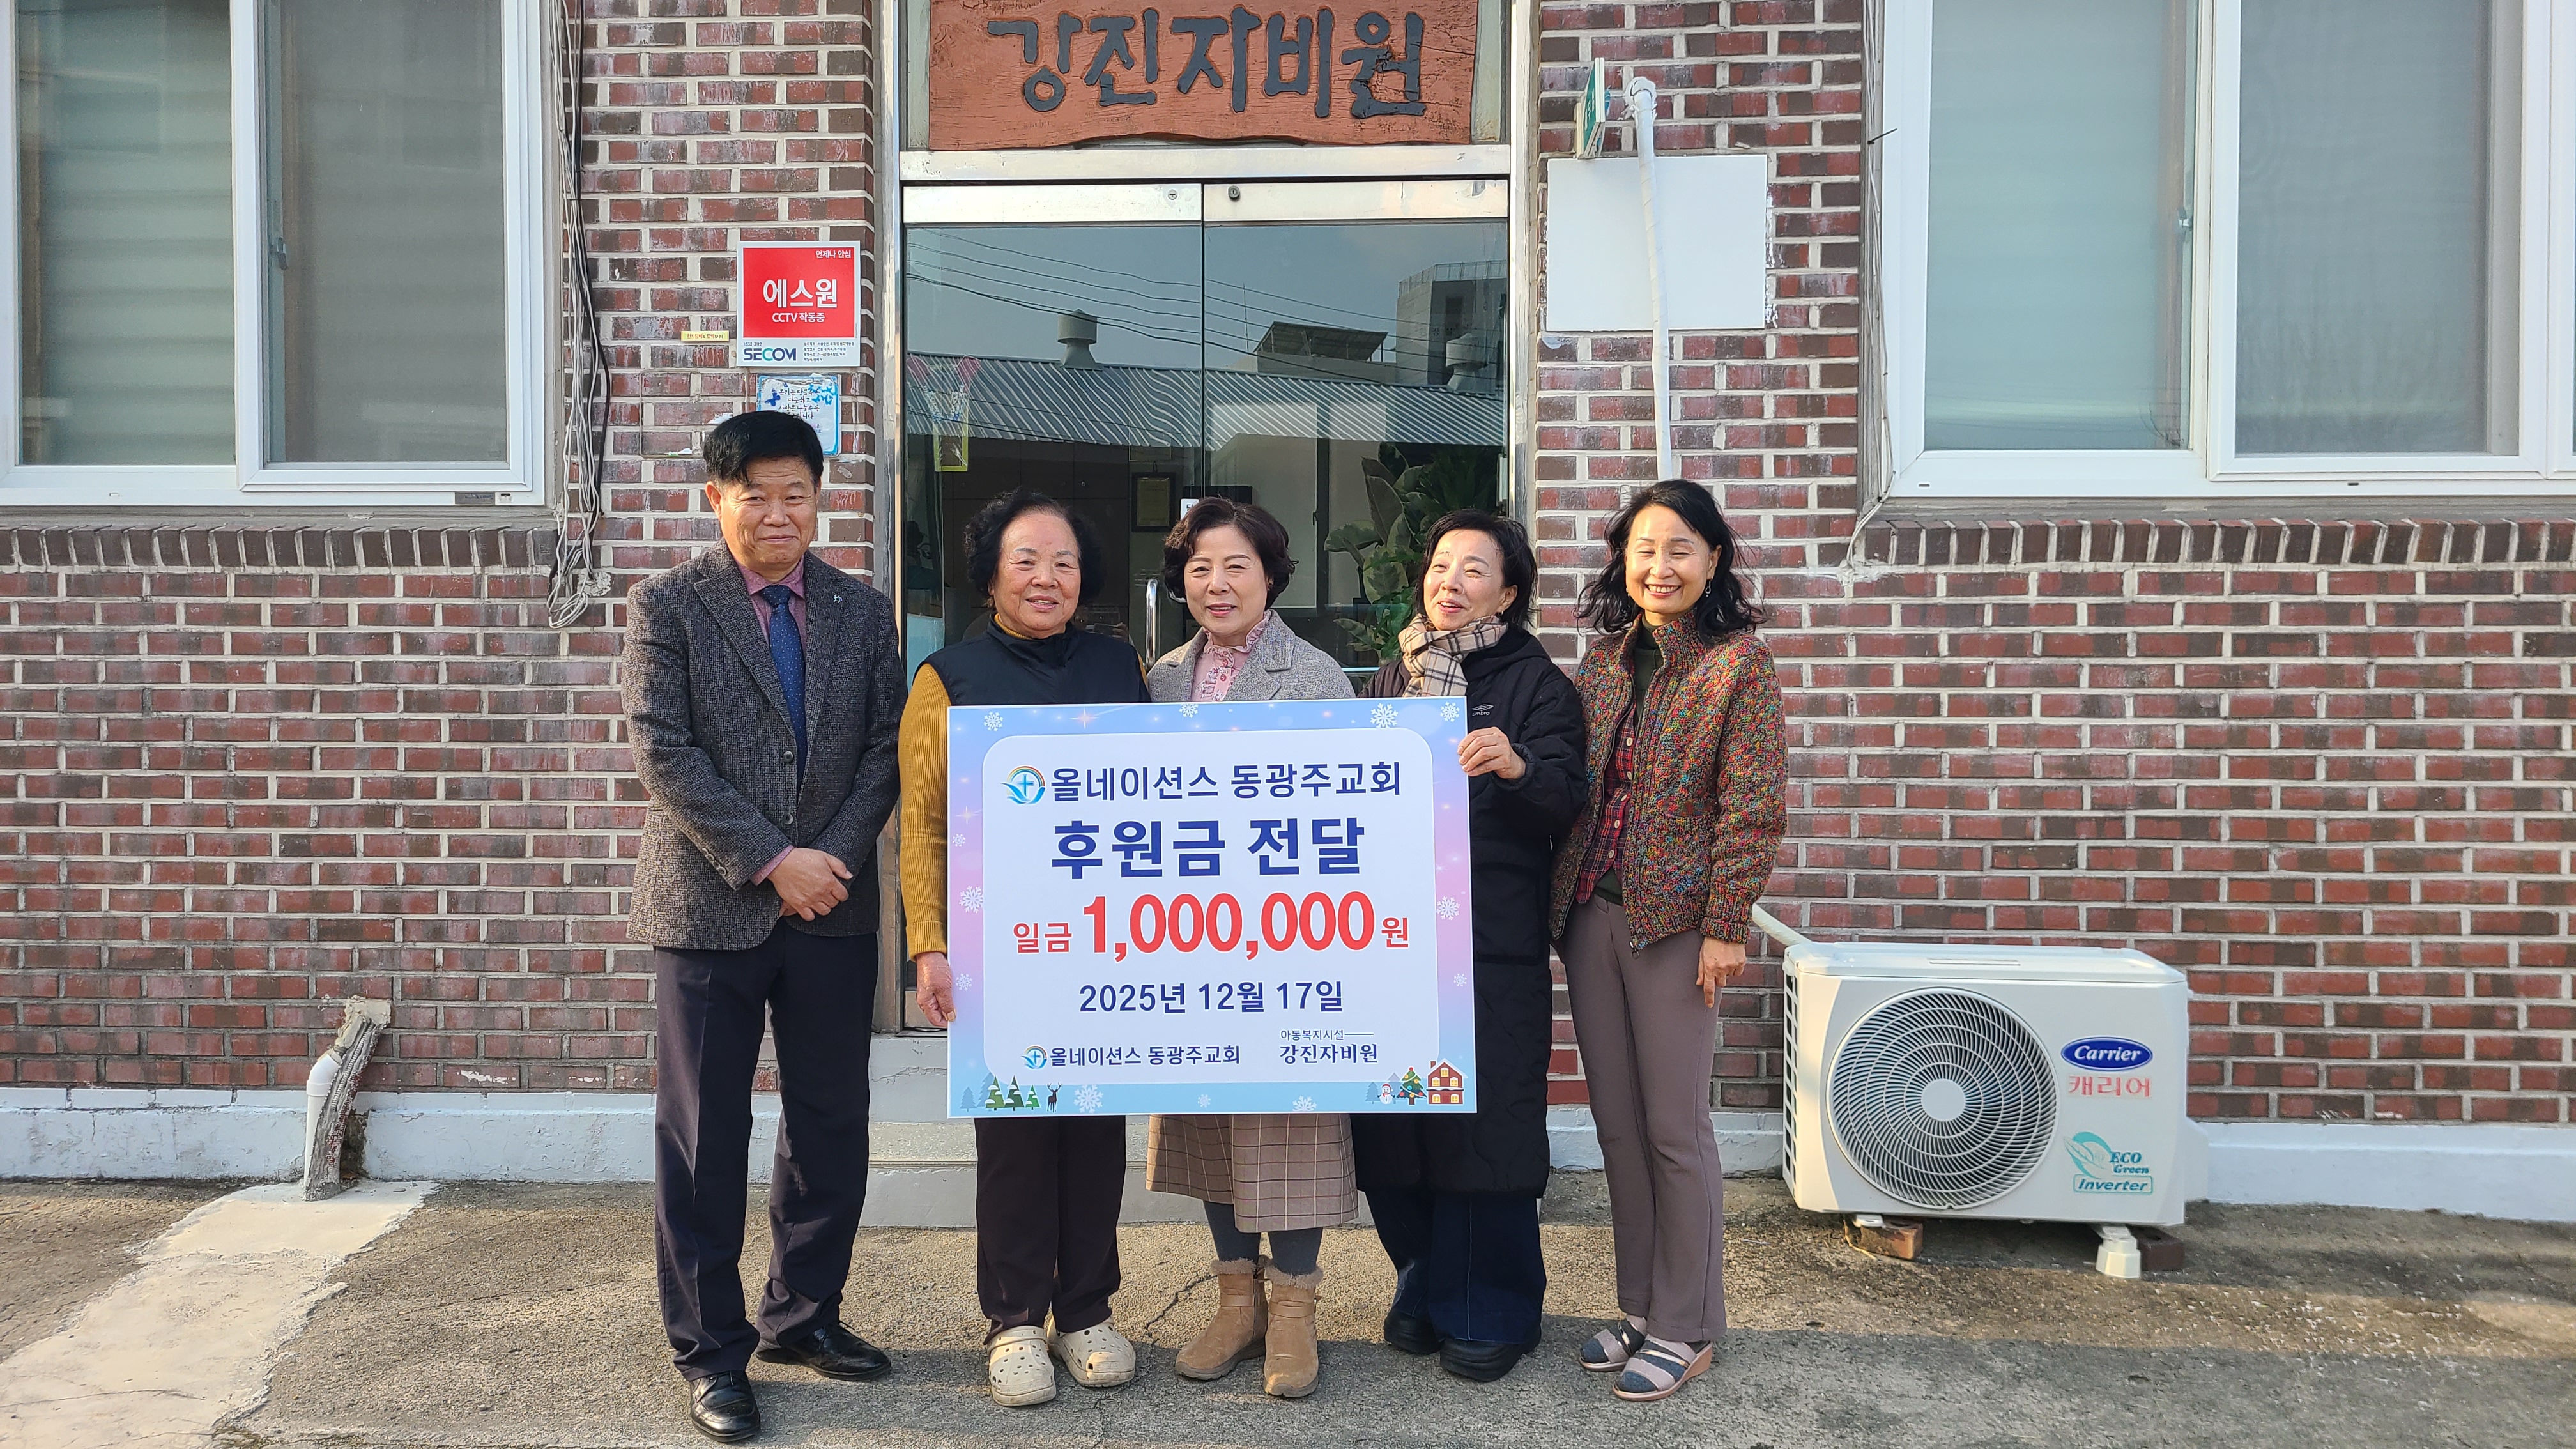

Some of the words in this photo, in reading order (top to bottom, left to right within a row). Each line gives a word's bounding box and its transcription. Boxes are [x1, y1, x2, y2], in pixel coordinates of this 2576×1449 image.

[986, 7, 1427, 119] 강진자비원
[815, 250, 836, 259] 언제나
[837, 250, 852, 259] 안심
[763, 279, 838, 308] 에스원
[772, 312, 798, 323] CCTV
[799, 312, 825, 323] 작동중
[743, 347, 797, 362] SECOM
[778, 403, 796, 411] 사랑은
[787, 395, 811, 404] 따뜻하고
[1051, 767, 1219, 802] 올네이션스
[1231, 761, 1401, 799] 동광주교회
[1052, 820, 1227, 880] 후원금
[1247, 817, 1366, 876] 전달
[1013, 923, 1073, 954] 일금
[1083, 891, 1376, 963] 1,000,000
[1381, 917, 1409, 949] 원
[1080, 983, 1187, 1015] 2025년
[1198, 981, 1265, 1013] 12월
[1276, 981, 1344, 1013] 17일
[1280, 1029, 1344, 1041] 아동복지시설
[1050, 1046, 1142, 1067] 올네이션스
[1147, 1045, 1241, 1066] 동광주교회
[1280, 1044, 1378, 1065] 강진자비원
[2074, 1045, 2141, 1062] Carrier
[2068, 1076, 2150, 1097] 캐리어
[2108, 1151, 2142, 1163] ECO
[2113, 1164, 2150, 1174] Green
[2078, 1178, 2148, 1191] Inverter
